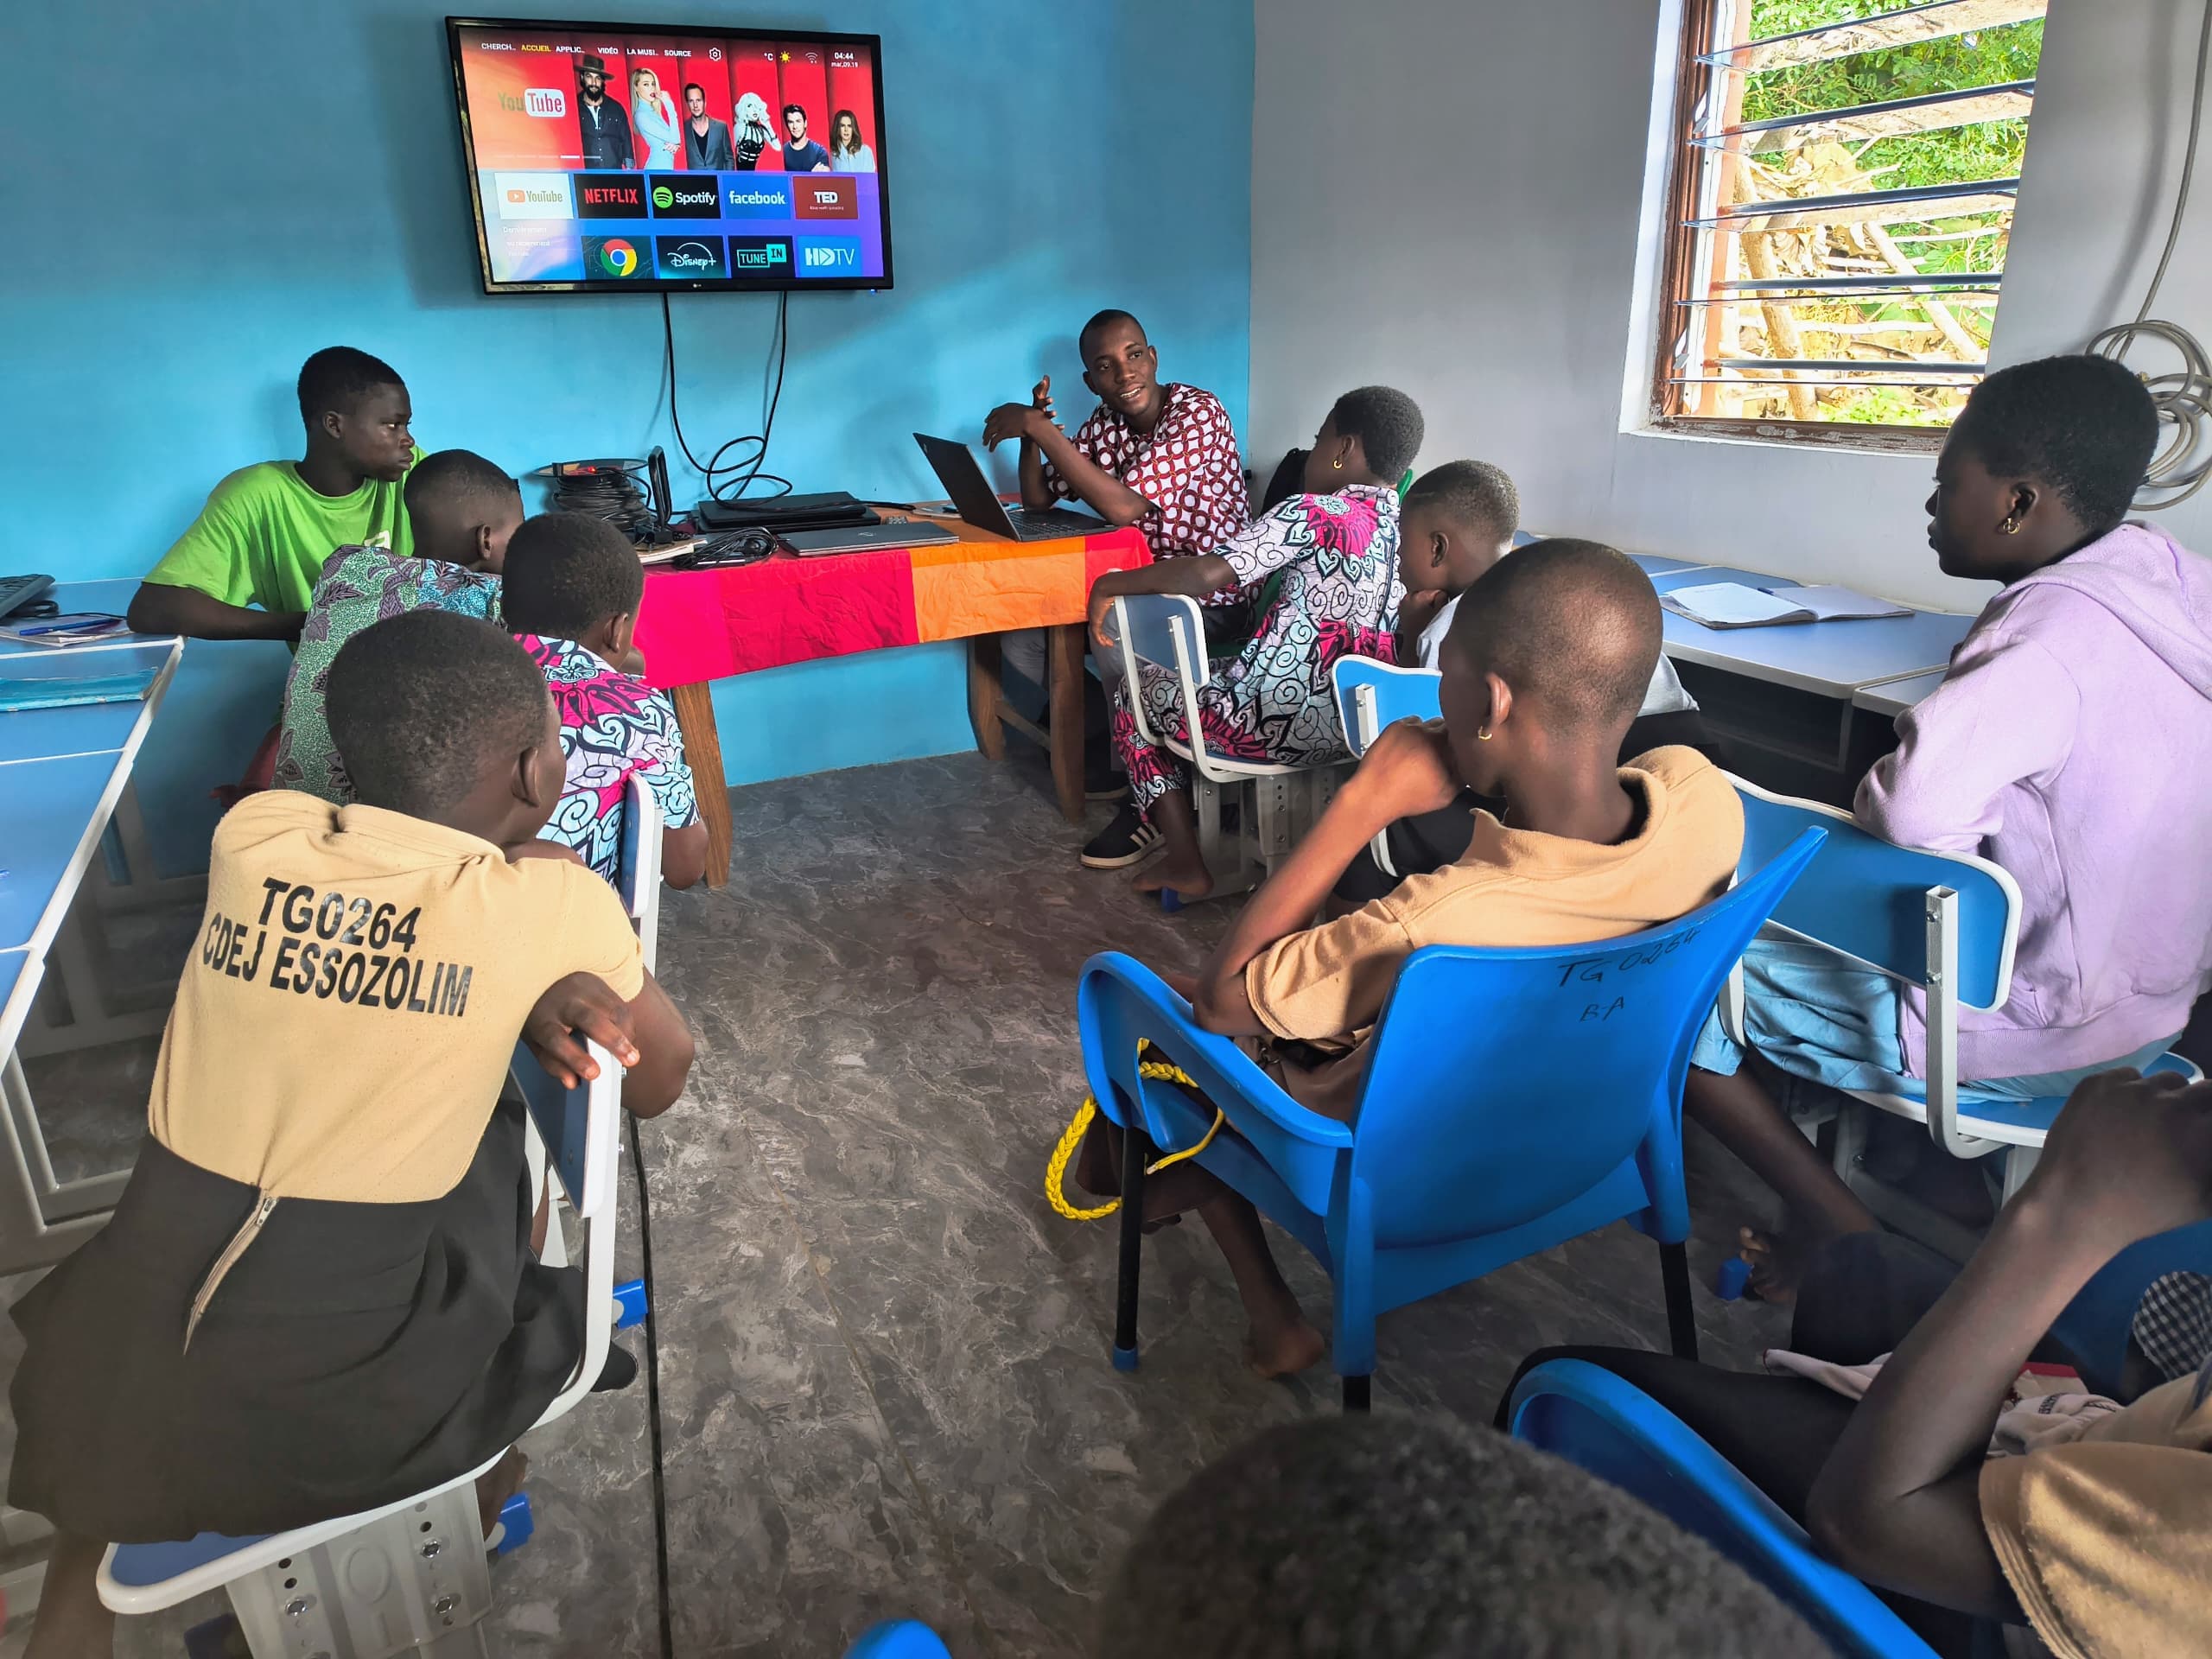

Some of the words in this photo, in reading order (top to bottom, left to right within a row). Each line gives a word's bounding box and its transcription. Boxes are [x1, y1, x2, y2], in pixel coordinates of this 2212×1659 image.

[498, 91, 563, 113] YouTube
[526, 190, 563, 203] YouTube
[584, 188, 639, 205] NETFLIX
[675, 191, 716, 206] Spotify
[729, 190, 785, 205] facebook
[814, 191, 838, 204] TED
[740, 253, 766, 264] TUNE
[771, 247, 783, 258] IN
[258, 877, 422, 952] TG0264
[203, 912, 267, 982] CDEJ
[270, 936, 474, 1018] ESSOZOLIM
